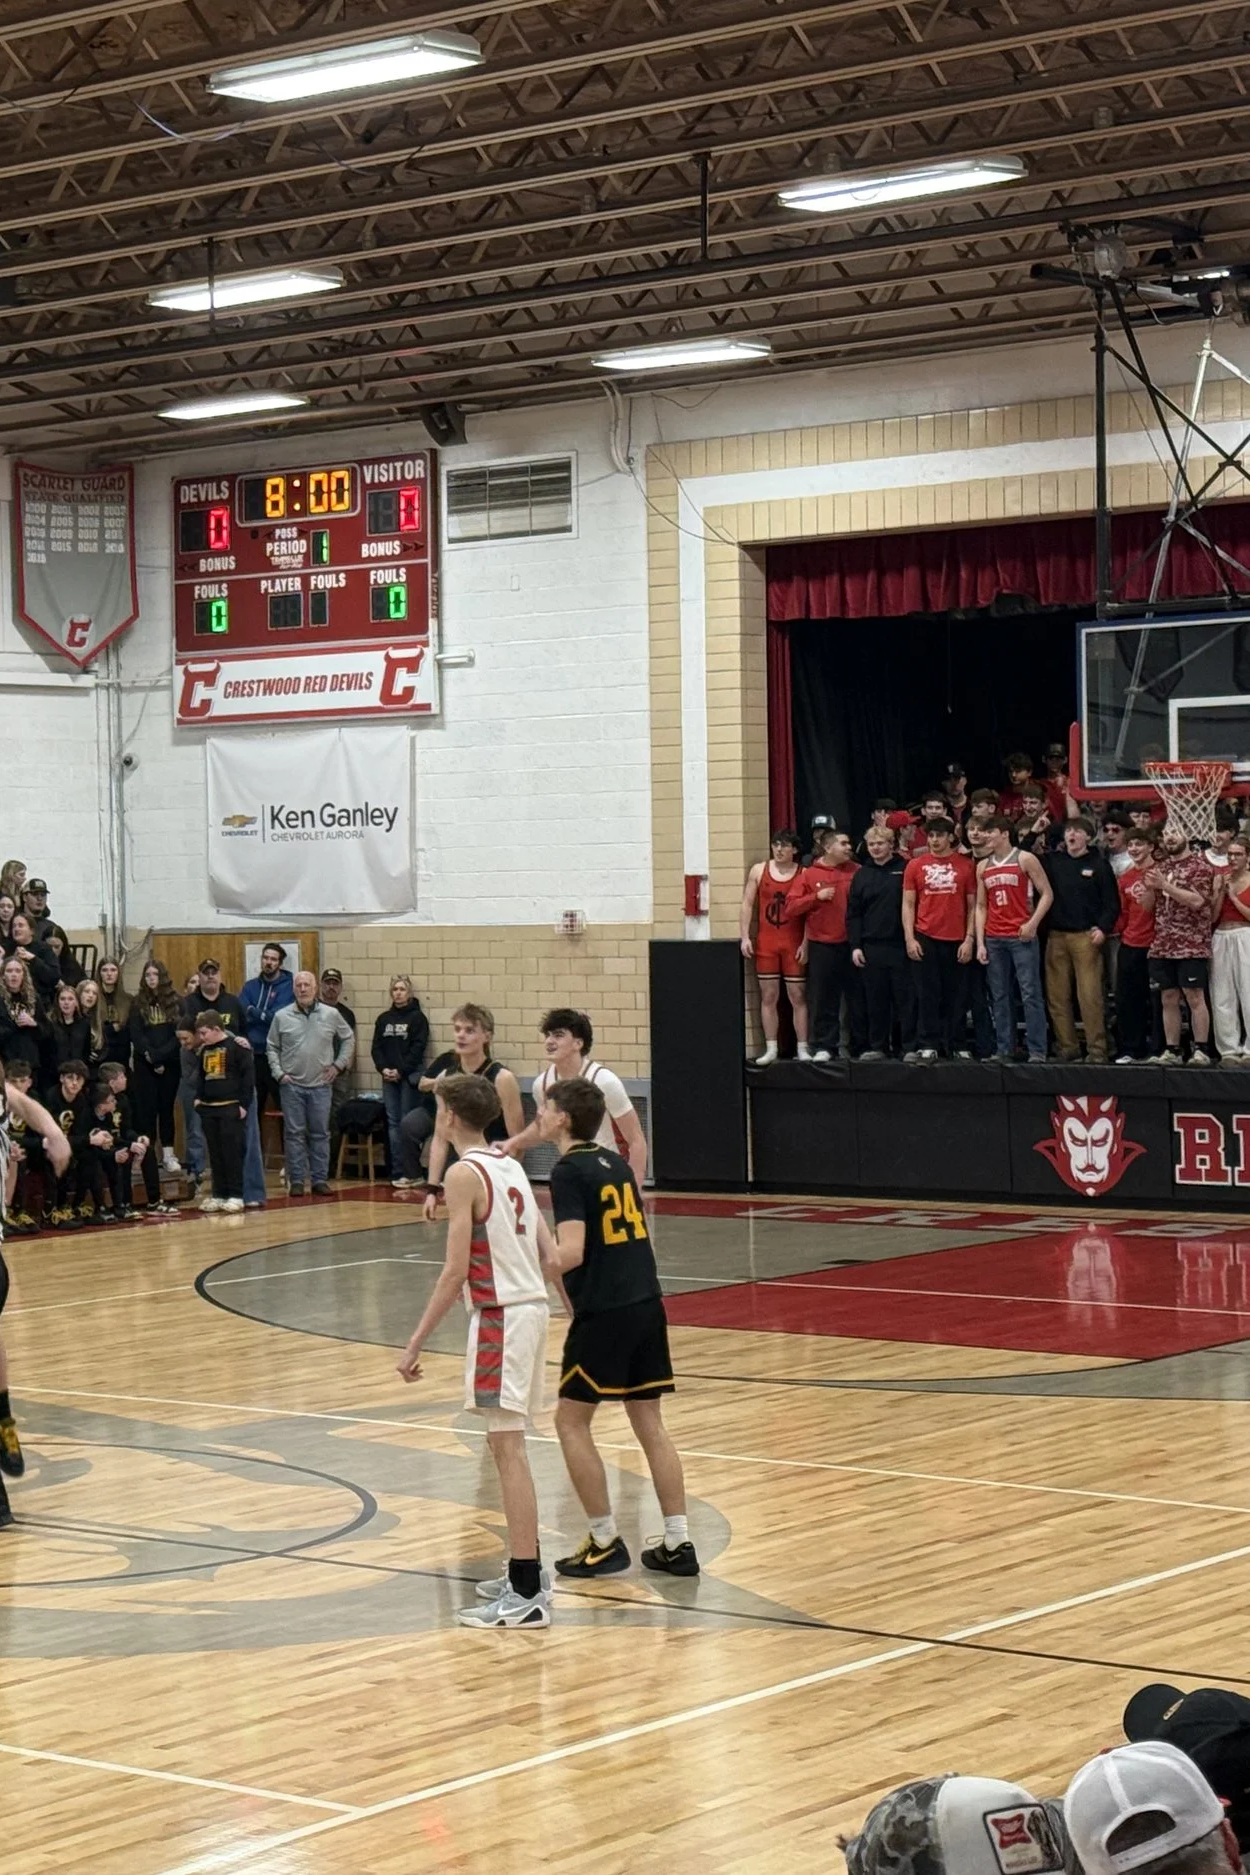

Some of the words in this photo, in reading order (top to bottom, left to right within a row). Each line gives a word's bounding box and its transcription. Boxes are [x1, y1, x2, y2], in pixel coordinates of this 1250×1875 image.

[22, 473, 75, 492] SCARLET
[81, 475, 125, 492] GUARD
[180, 480, 230, 503] DEVILS
[363, 459, 425, 484] VISITOR
[265, 470, 350, 518] 8:00
[400, 487, 420, 531] 0
[209, 507, 230, 550] 0
[275, 527, 297, 540] POSS
[266, 540, 307, 557] PERIOD
[361, 540, 400, 558] BONUS
[199, 555, 236, 573] BONUS
[370, 567, 407, 585] FOULS
[194, 583, 228, 599] FOULS
[260, 577, 302, 594] PLAYER
[310, 573, 346, 590] FOULS
[389, 584, 406, 619] 0
[211, 600, 227, 633] 0
[223, 676, 300, 700] CRESTWOOD
[303, 674, 327, 695] RED
[329, 671, 374, 691] DEVILS
[269, 804, 316, 830] Ken
[319, 802, 399, 833] Ganley
[221, 829, 259, 837] CHEVROLET
[271, 831, 324, 843] CHEVROLET
[326, 830, 365, 841] AURORA
[507, 1187, 526, 1235] 2
[600, 1182, 647, 1245] 24
